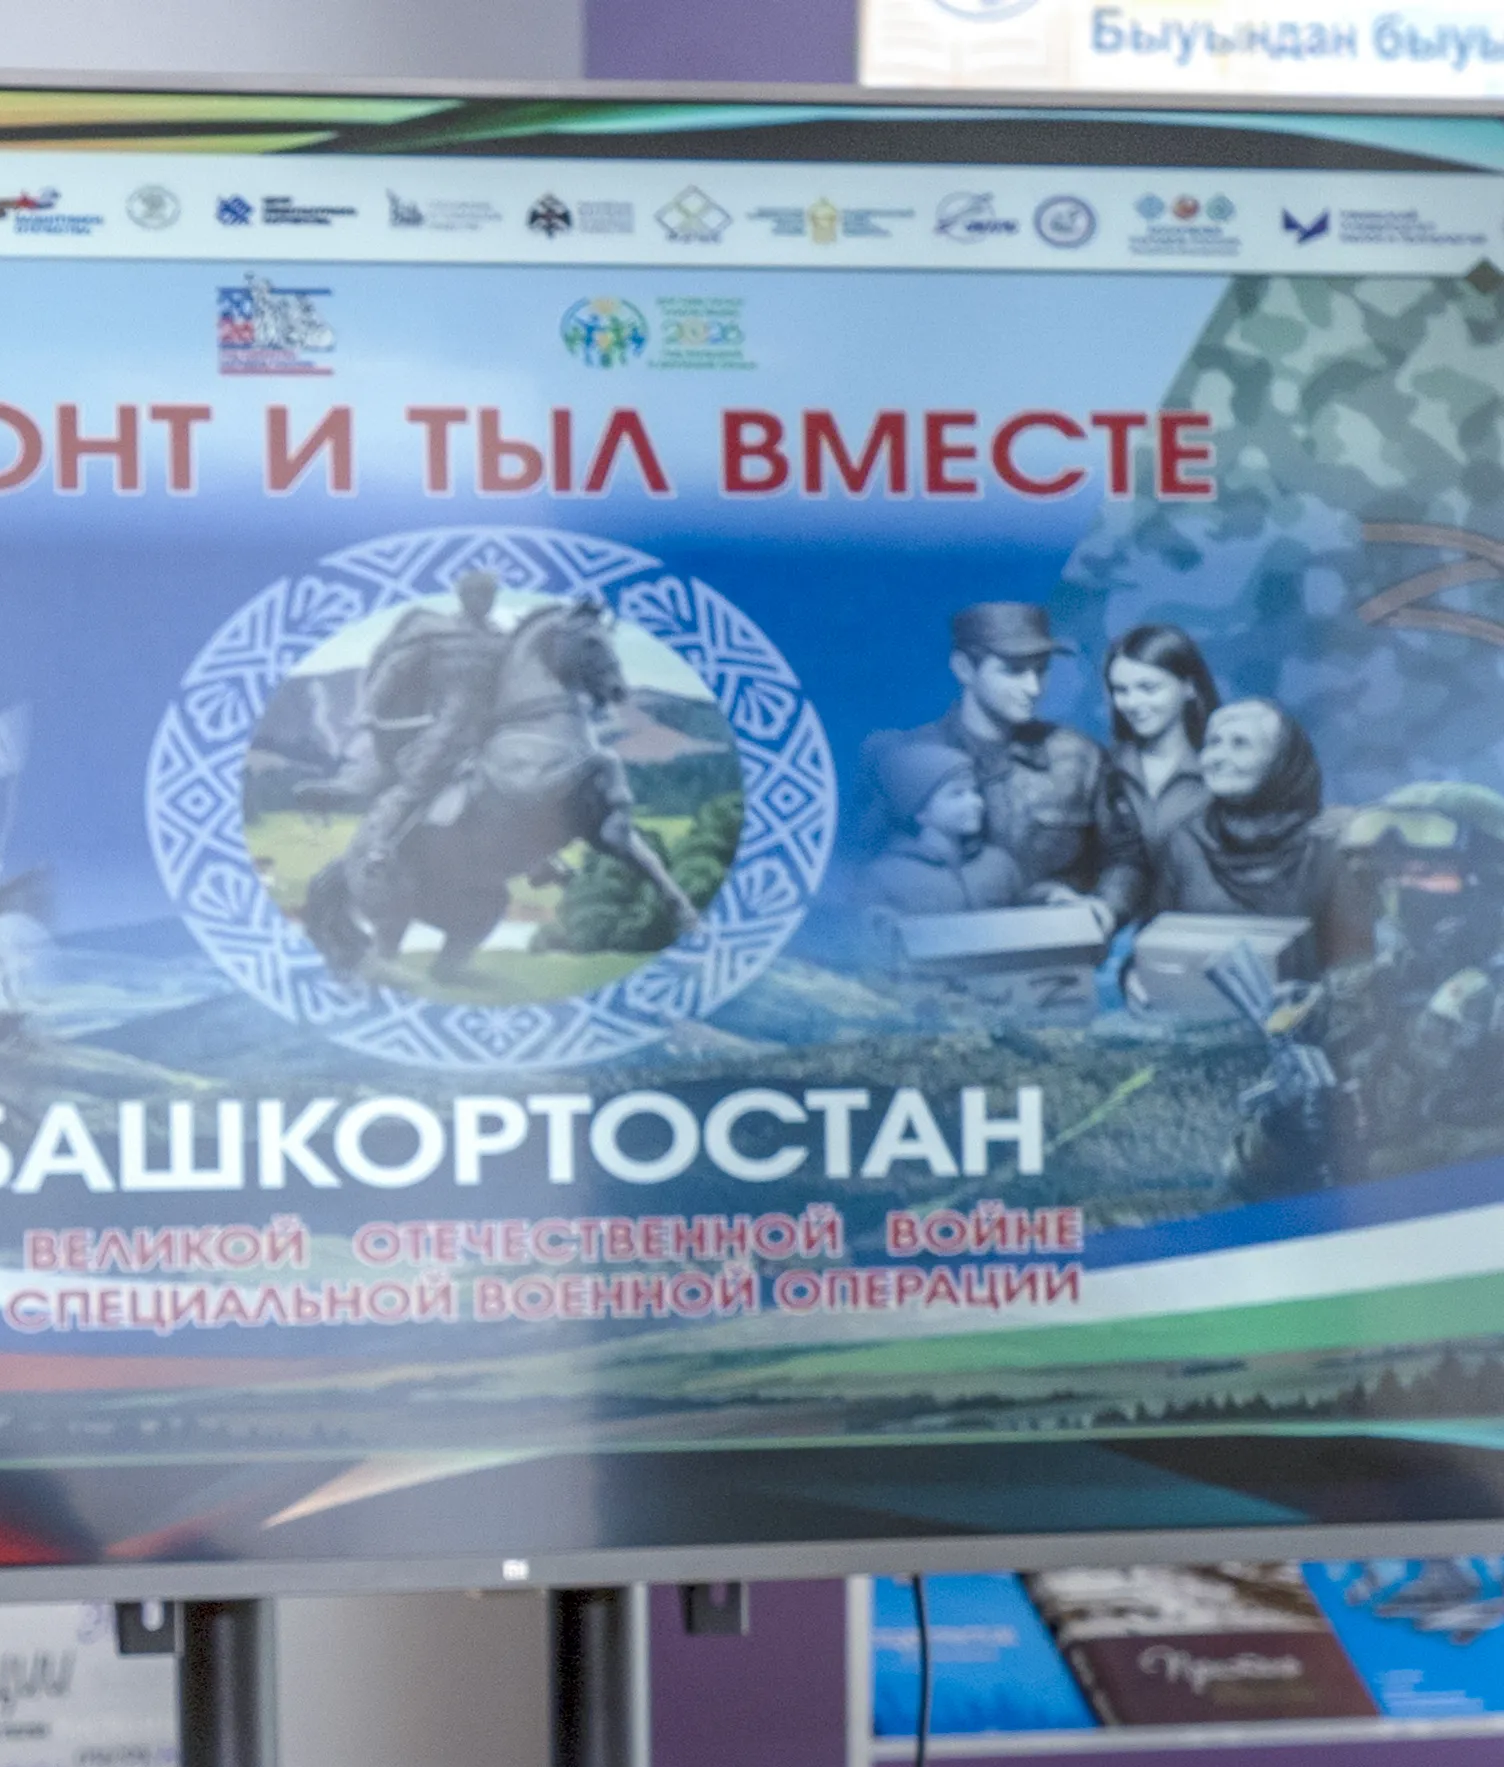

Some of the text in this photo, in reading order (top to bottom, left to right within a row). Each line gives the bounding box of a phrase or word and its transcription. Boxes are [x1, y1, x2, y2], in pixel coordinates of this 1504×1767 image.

[264, 404, 355, 492] И
[405, 406, 672, 498] ТЫЛ
[720, 408, 1217, 500] ВМЕСТЕ
[24, 1214, 310, 1273] ВЕЛИКОЙ
[353, 1202, 844, 1267] ОТЕЧЕСТВЕННОЙ
[886, 1200, 1085, 1257] ВОЙНЕ
[4, 1267, 458, 1335] СПЕЦИАЛЬНОЙ
[473, 1259, 760, 1321] ВОЕННОЙ
[773, 1262, 1083, 1315] ОПЕРАЦИИ
